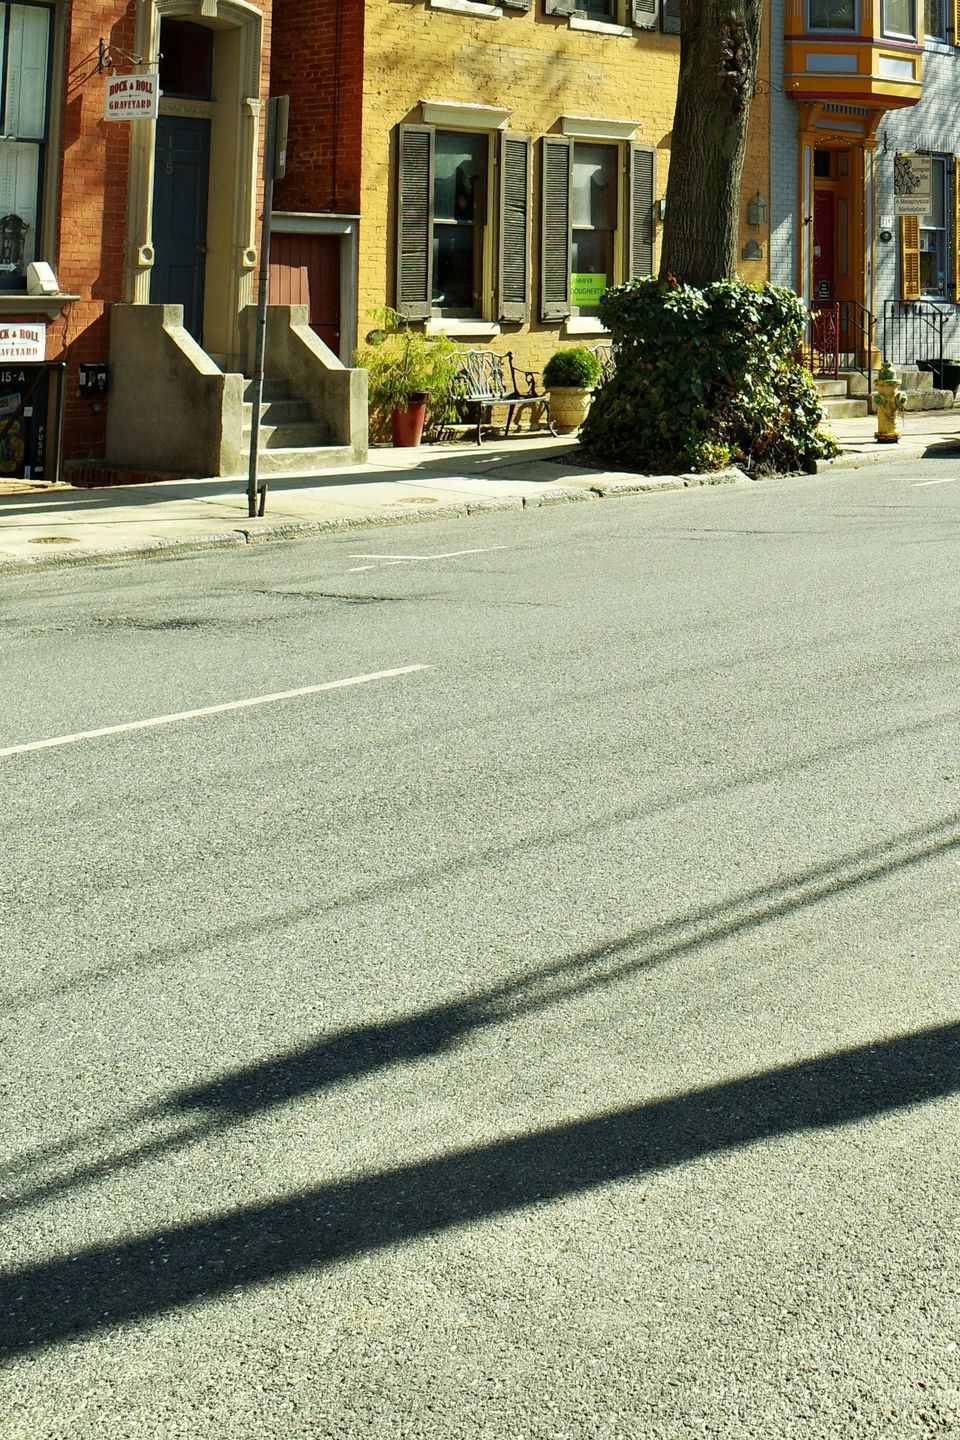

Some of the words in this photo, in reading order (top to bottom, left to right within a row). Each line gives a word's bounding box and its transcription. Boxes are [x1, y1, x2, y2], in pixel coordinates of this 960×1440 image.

[109, 80, 128, 96] ROCK
[129, 82, 134, 90] &
[136, 80, 153, 94] ROLL
[108, 100, 152, 109] GRAVEYARD
[20, 329, 39, 342] ROLL
